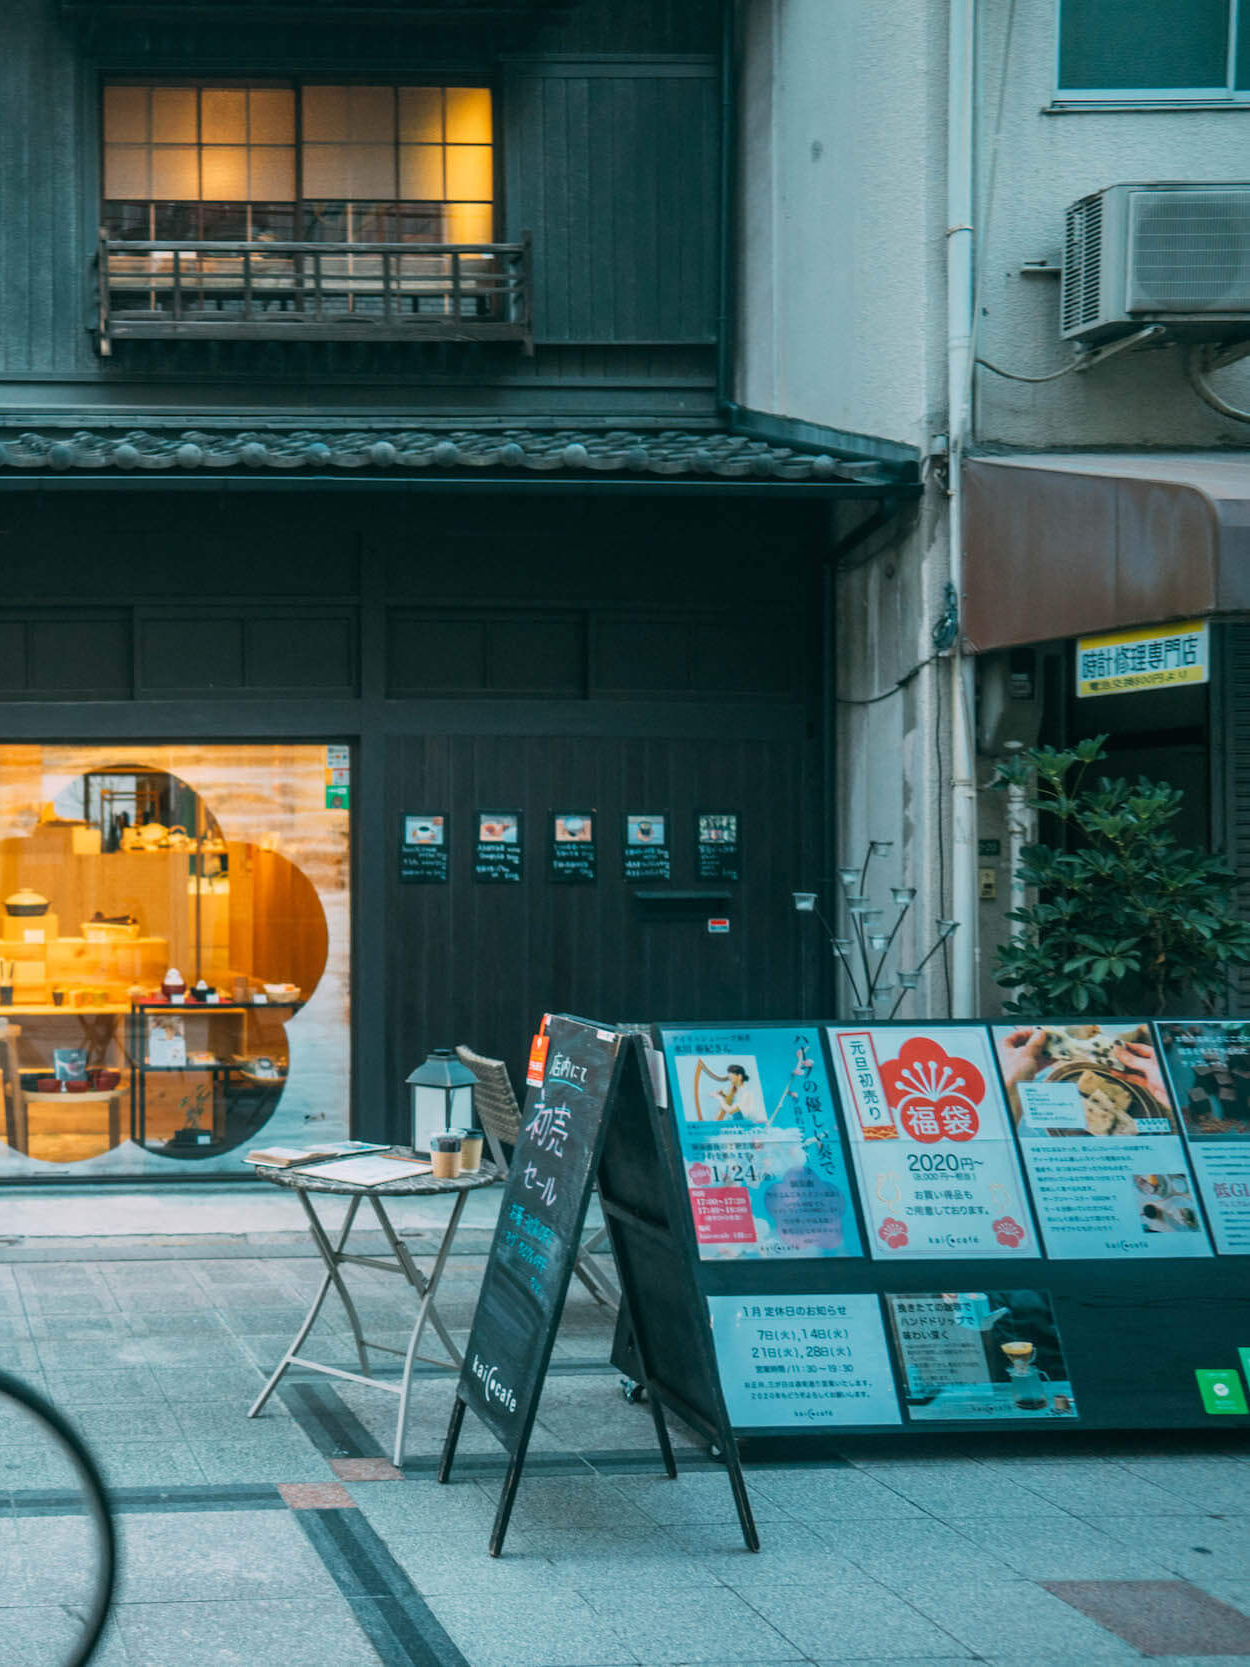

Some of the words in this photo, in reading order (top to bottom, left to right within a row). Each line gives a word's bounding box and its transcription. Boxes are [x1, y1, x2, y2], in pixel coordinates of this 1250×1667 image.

[849, 1040, 882, 1121] 元旦初売り
[906, 1105, 975, 1136] 福袋
[524, 1161, 557, 1207] セール
